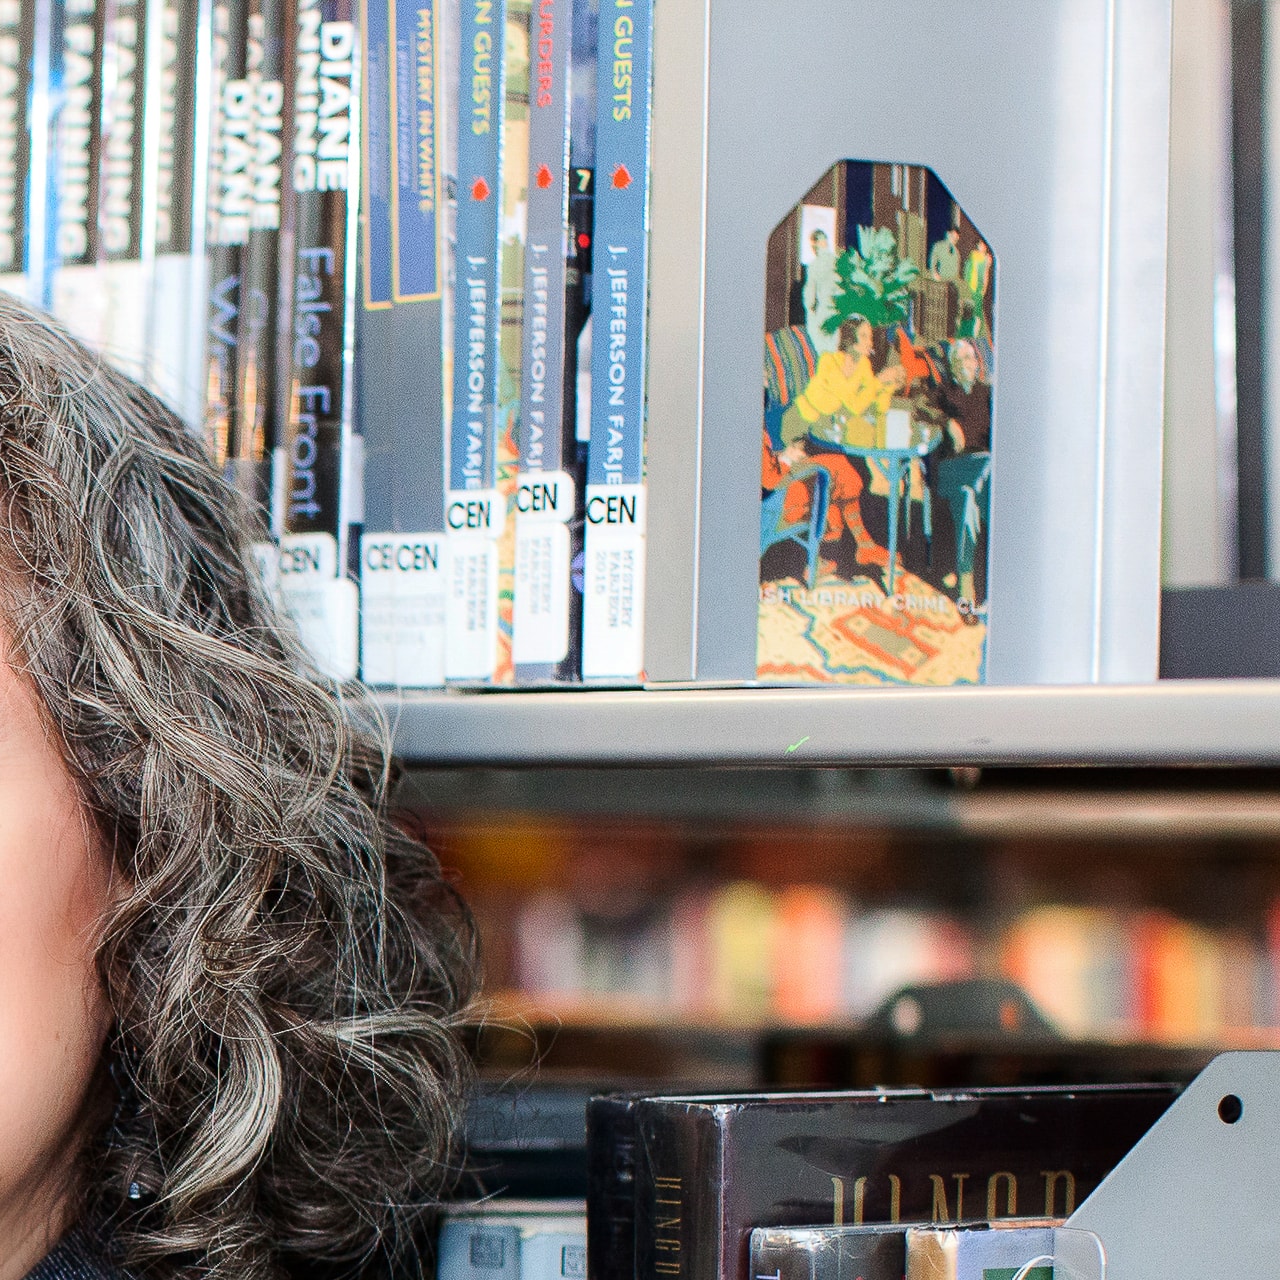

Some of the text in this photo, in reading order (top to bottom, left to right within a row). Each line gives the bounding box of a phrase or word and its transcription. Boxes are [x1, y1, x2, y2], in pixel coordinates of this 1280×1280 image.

[316, 21, 354, 193] DIANE
[416, 9, 434, 213] MYSTERY IN WHITE
[472, 31, 492, 136] GUESTS
[612, 15, 634, 122] GUESTS
[58, 24, 95, 257] FANNING
[104, 16, 138, 252] FANNING
[217, 80, 253, 245] DIANE
[251, 80, 284, 230] DIANE
[575, 169, 591, 192] 7
[467, 255, 487, 271] J.
[608, 246, 628, 261] J.
[289, 247, 336, 520] False Front
[467, 278, 487, 414] JEFFERSON
[526, 244, 548, 473] J. JEFFERSON FARJ
[607, 268, 628, 406] JEFFERSON
[447, 500, 491, 529] CEN
[517, 483, 558, 512] CEN
[586, 496, 636, 524] CEN
[397, 543, 439, 571] CEN
[608, 551, 621, 628] FARJEON
[621, 549, 634, 628] MYSTERY
[799, 589, 884, 609] LIBRARY
[892, 593, 950, 614] CRIME
